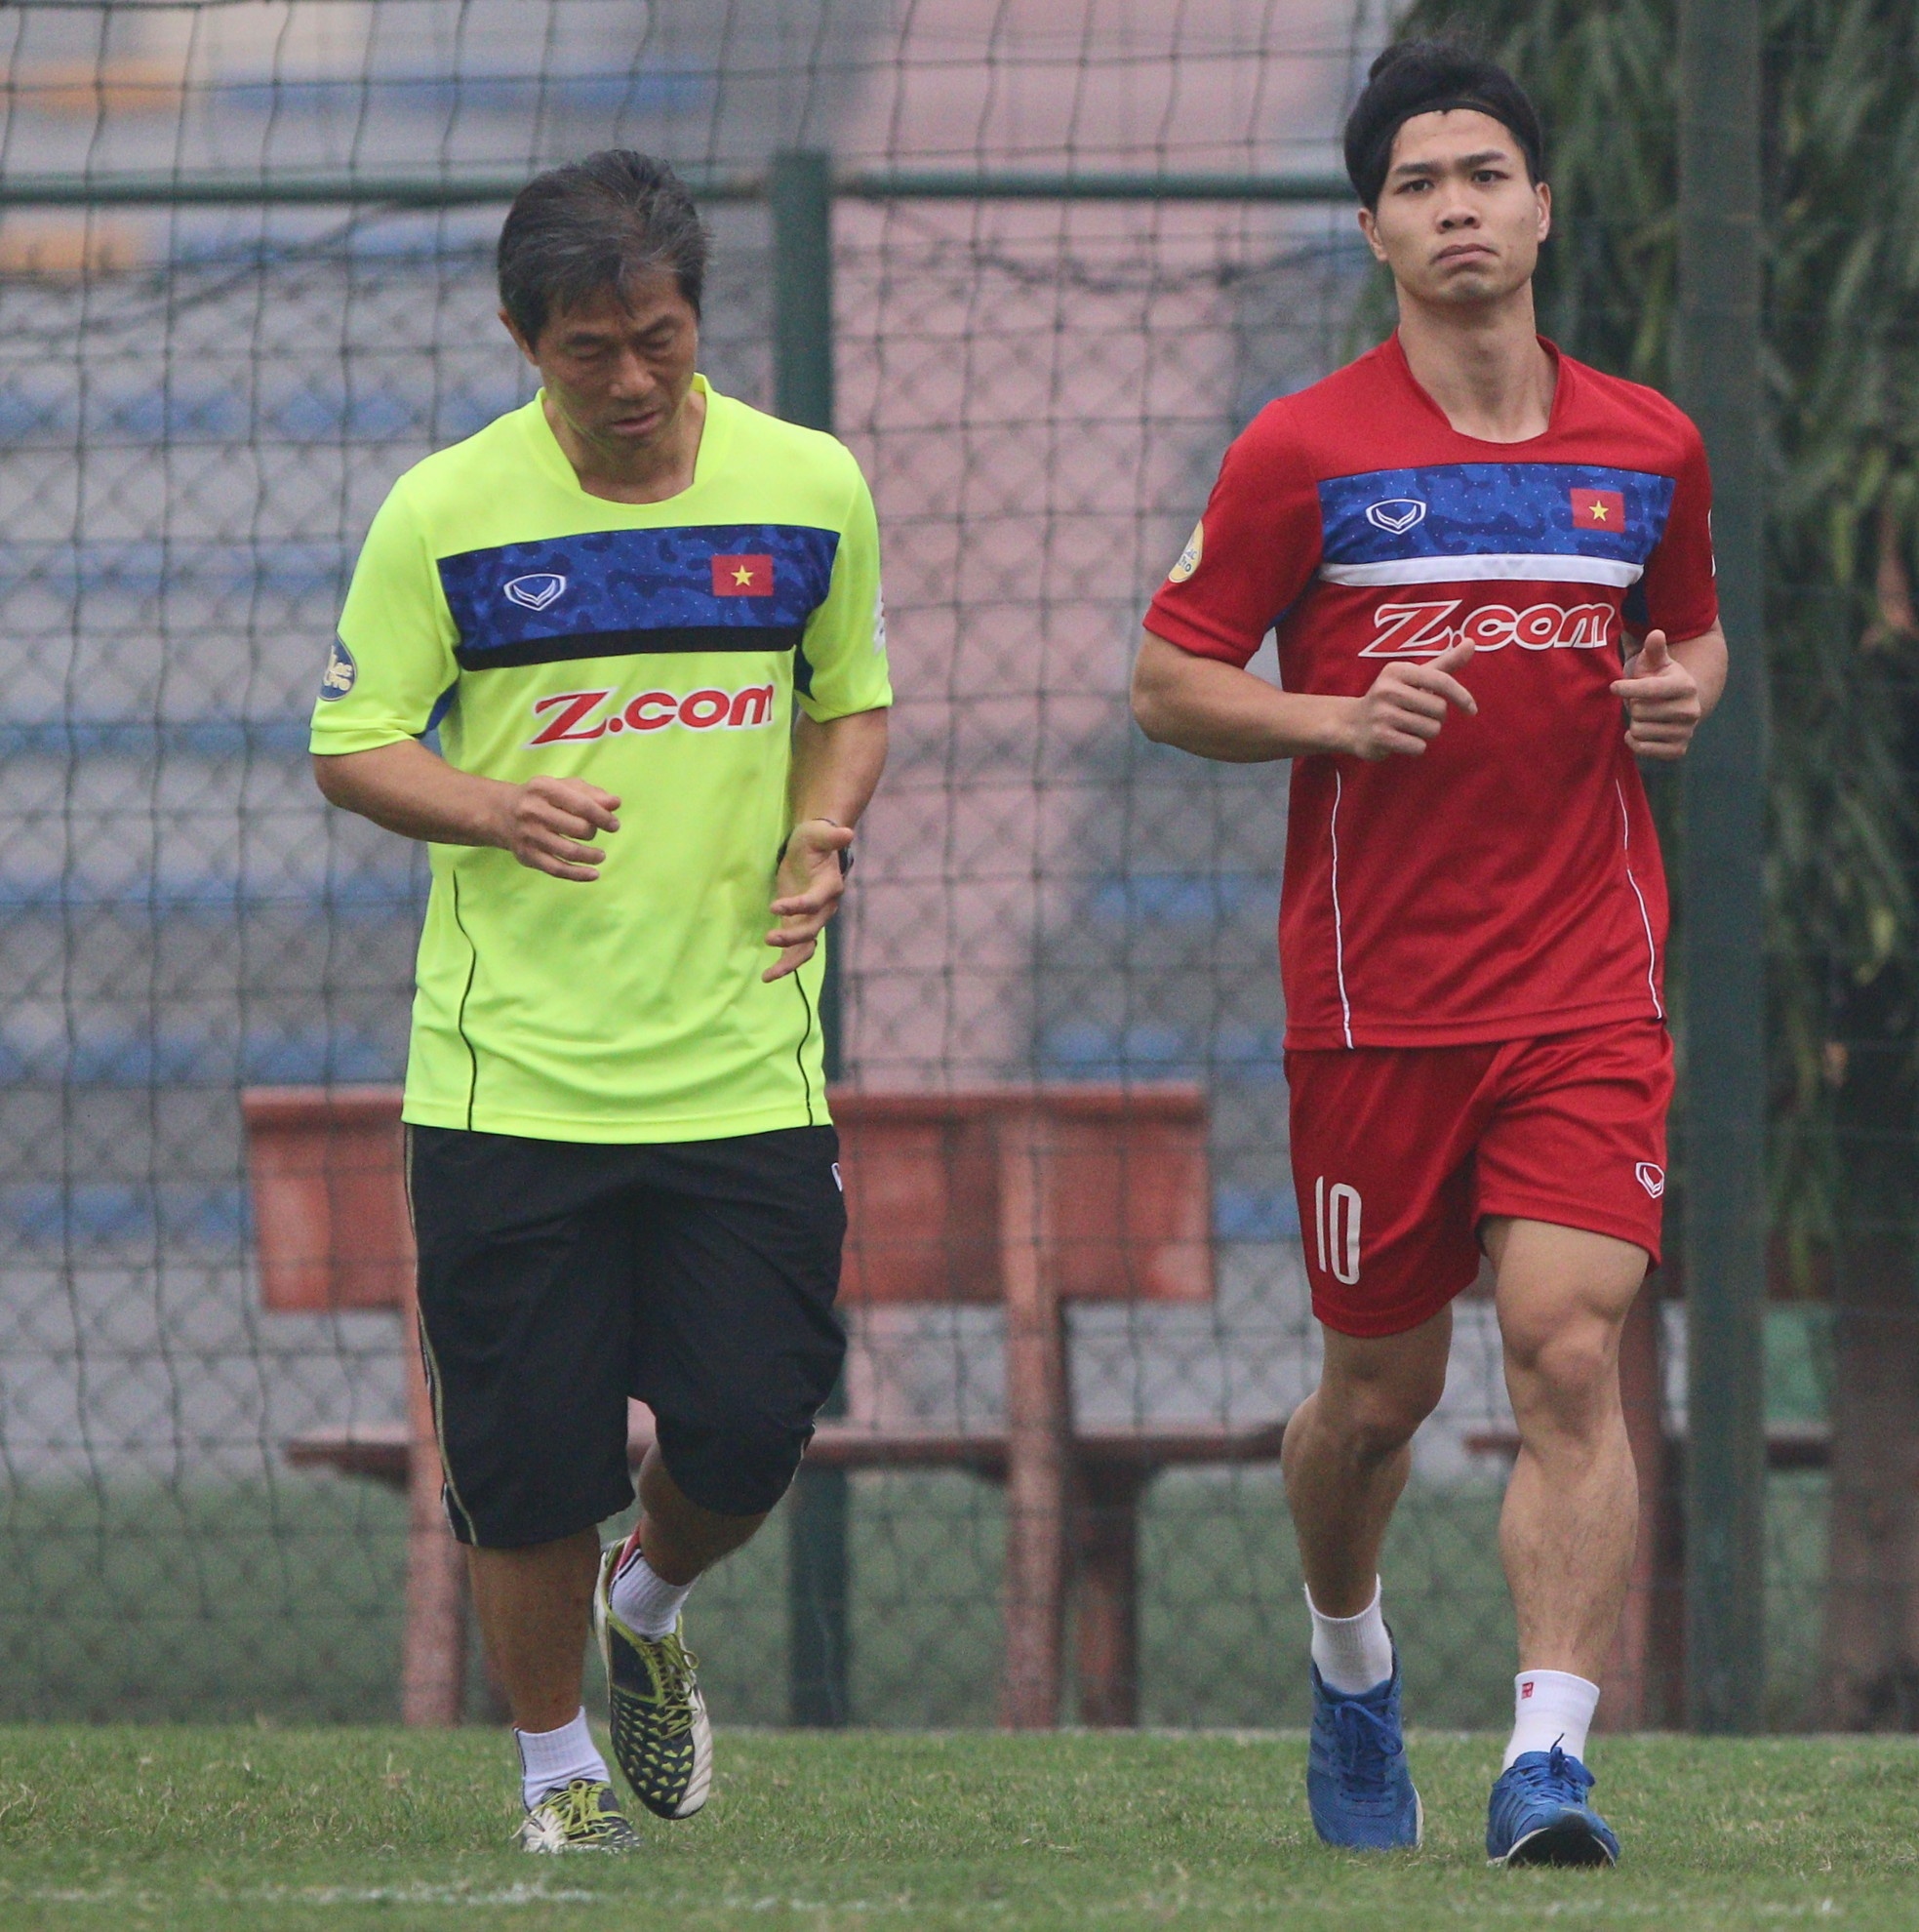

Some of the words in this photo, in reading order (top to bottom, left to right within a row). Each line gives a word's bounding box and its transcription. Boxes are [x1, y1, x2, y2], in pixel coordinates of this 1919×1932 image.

[1357, 599, 1615, 658] Z.com
[525, 684, 775, 747] Z.com
[1315, 1176, 1362, 1285] 10
